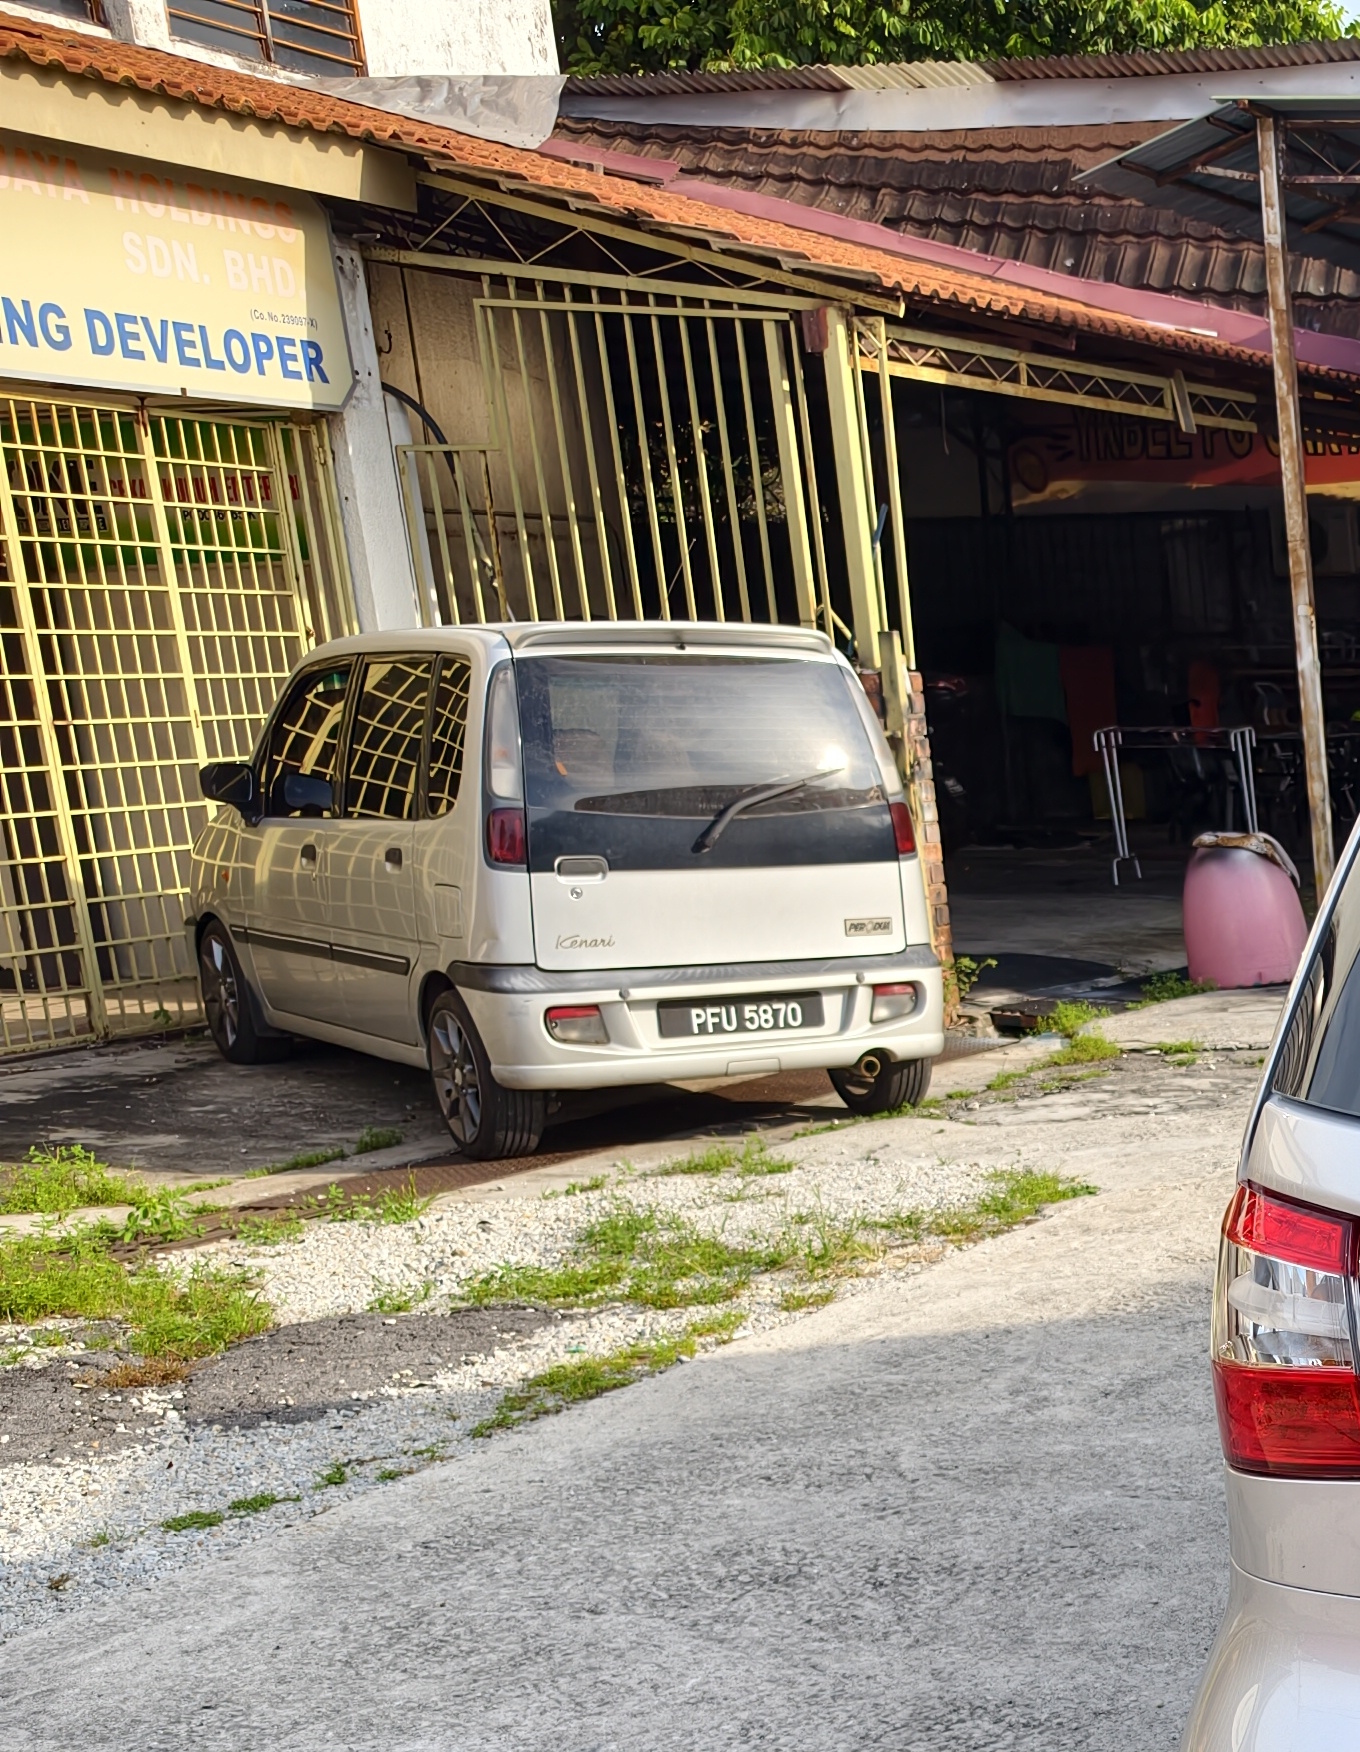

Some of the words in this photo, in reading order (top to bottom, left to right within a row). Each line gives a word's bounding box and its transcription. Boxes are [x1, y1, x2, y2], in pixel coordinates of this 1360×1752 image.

[108, 167, 298, 244] HOLDINGS
[122, 231, 211, 285] SDN.
[84, 307, 330, 384] DEVELOPER
[555, 934, 616, 950] Kenari
[691, 1004, 737, 1034] PFU
[744, 1002, 802, 1030] 5870
